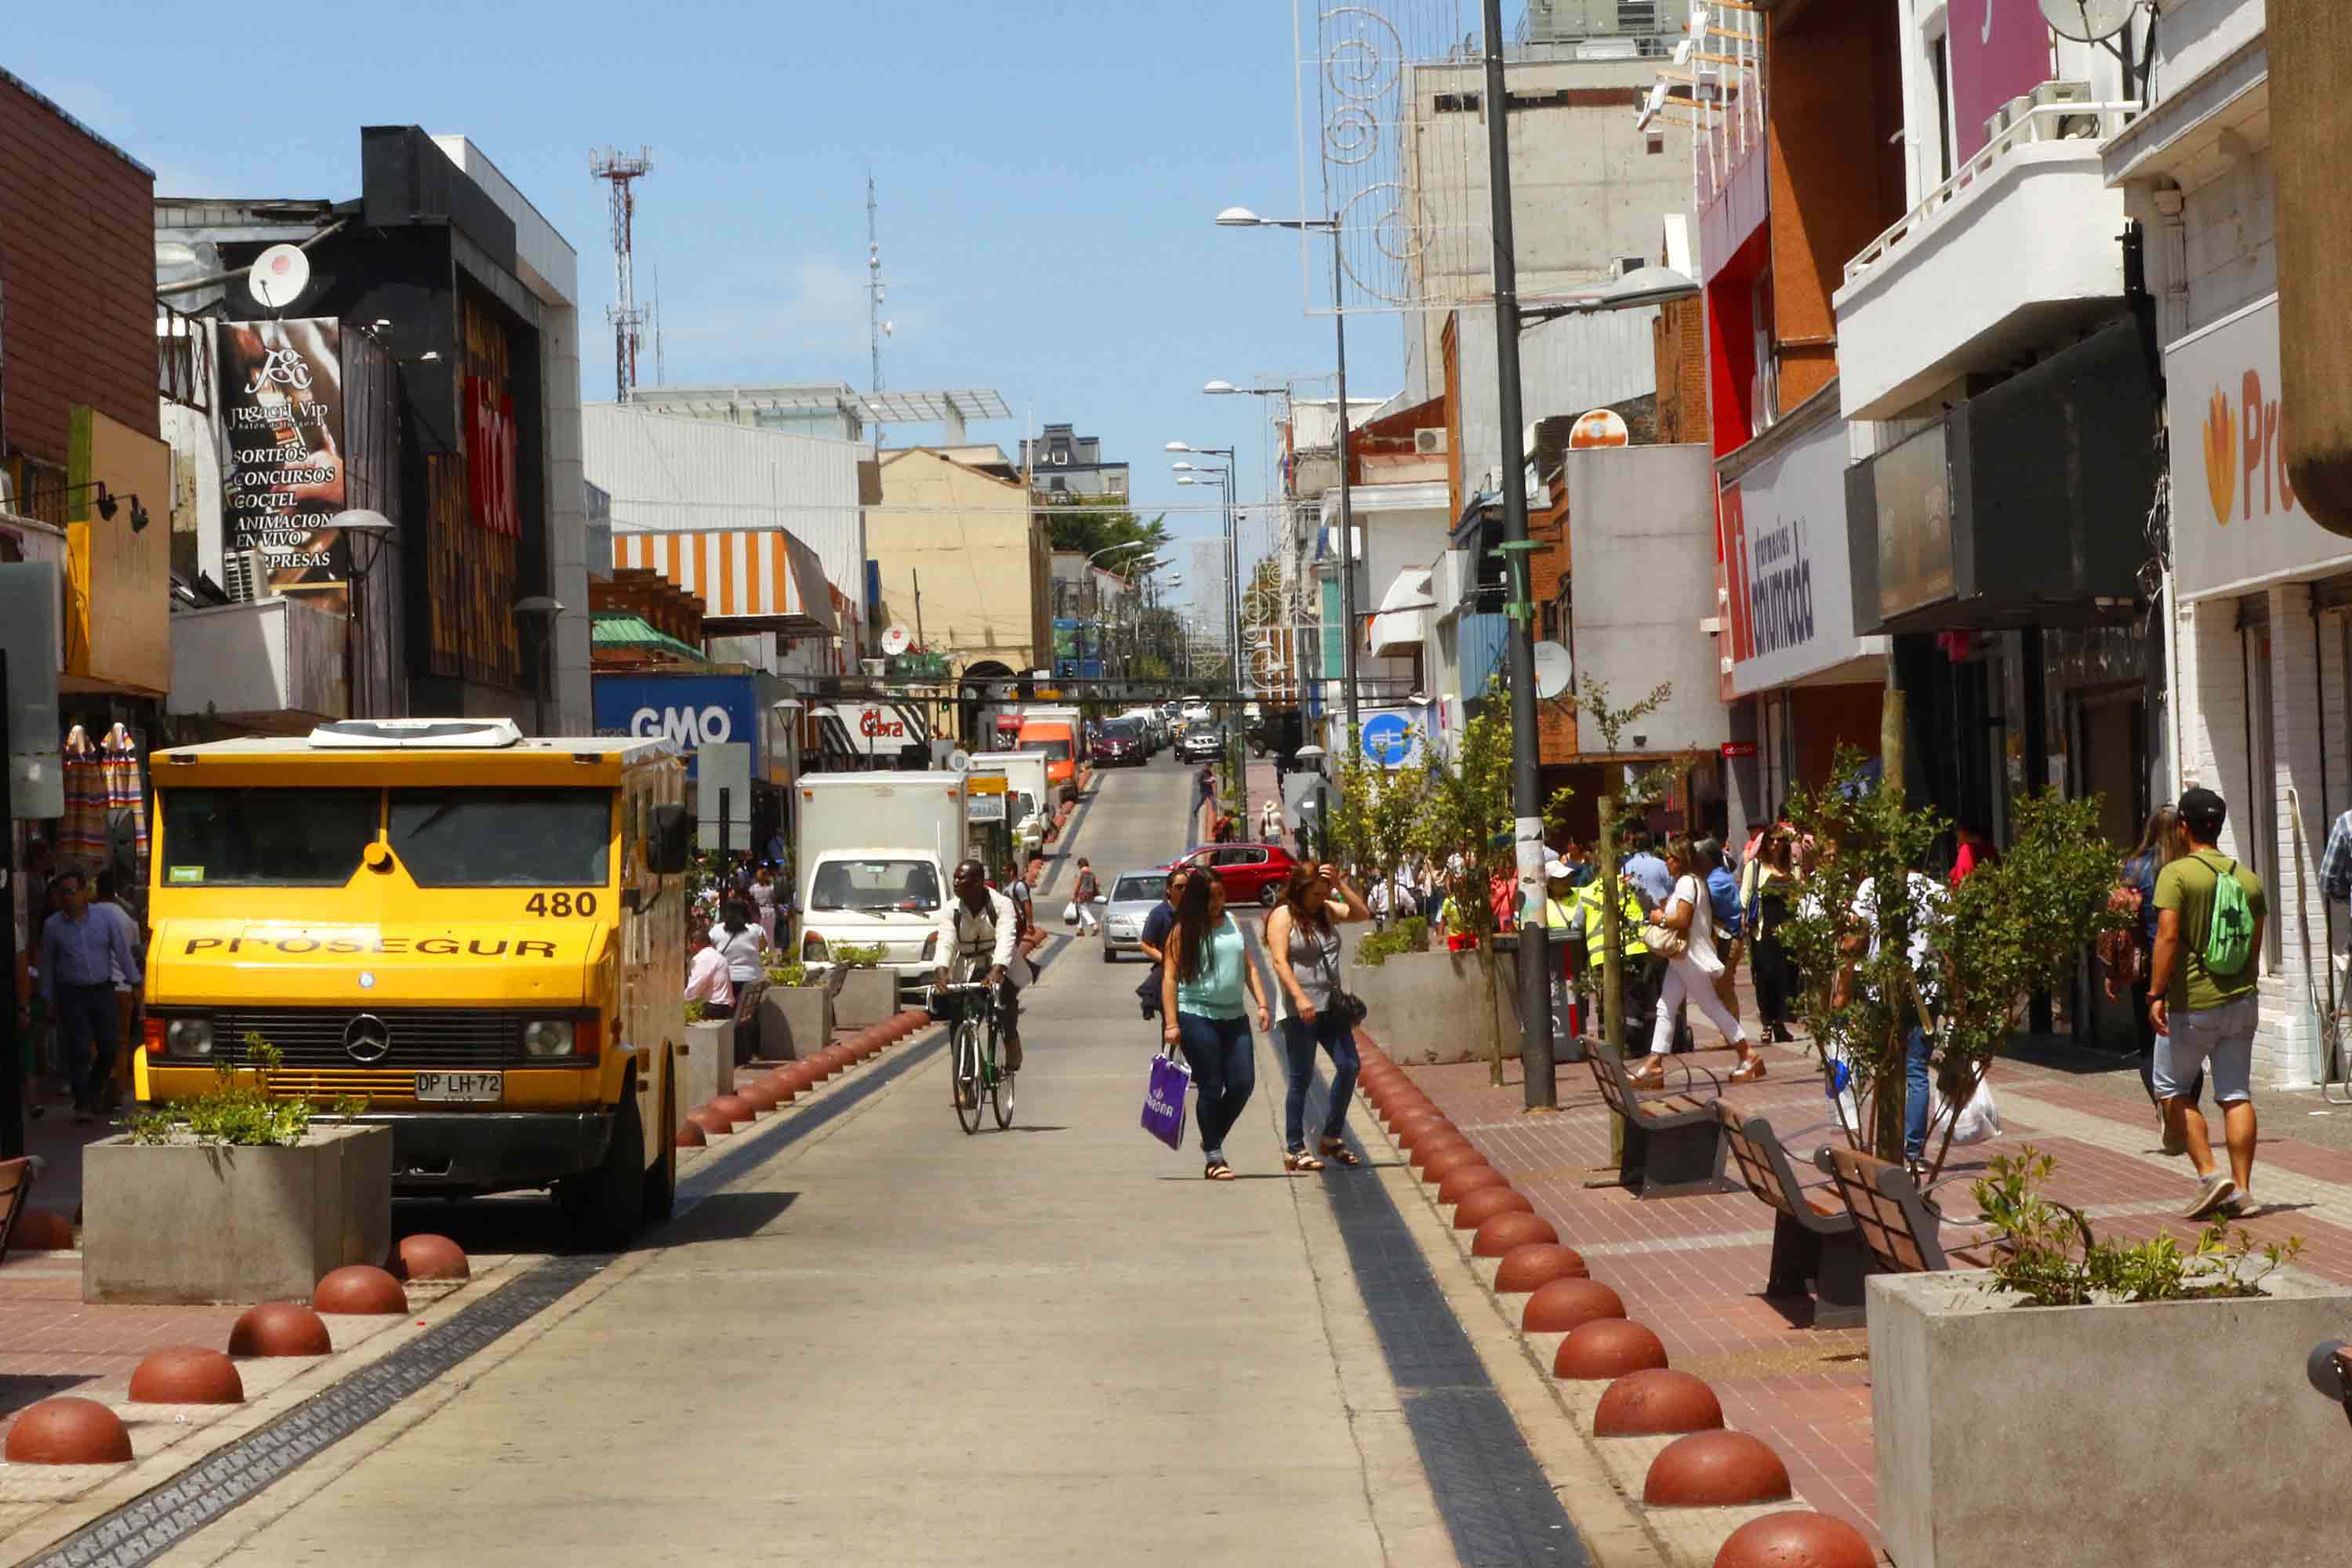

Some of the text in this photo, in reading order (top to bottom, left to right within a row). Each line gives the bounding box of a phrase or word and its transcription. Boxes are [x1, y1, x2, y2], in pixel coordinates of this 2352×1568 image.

[299, 401, 328, 426] Vip
[233, 447, 307, 464] SORTEOS
[234, 467, 335, 486] CONCURSOS
[235, 492, 298, 509] COCTEL
[235, 514, 333, 531] ANIMACION
[237, 531, 302, 550] EN VIVO
[263, 552, 331, 568] RPRESAS
[631, 706, 731, 747] GMO
[525, 891, 597, 917] 480
[184, 938, 557, 958] PROSEGUR
